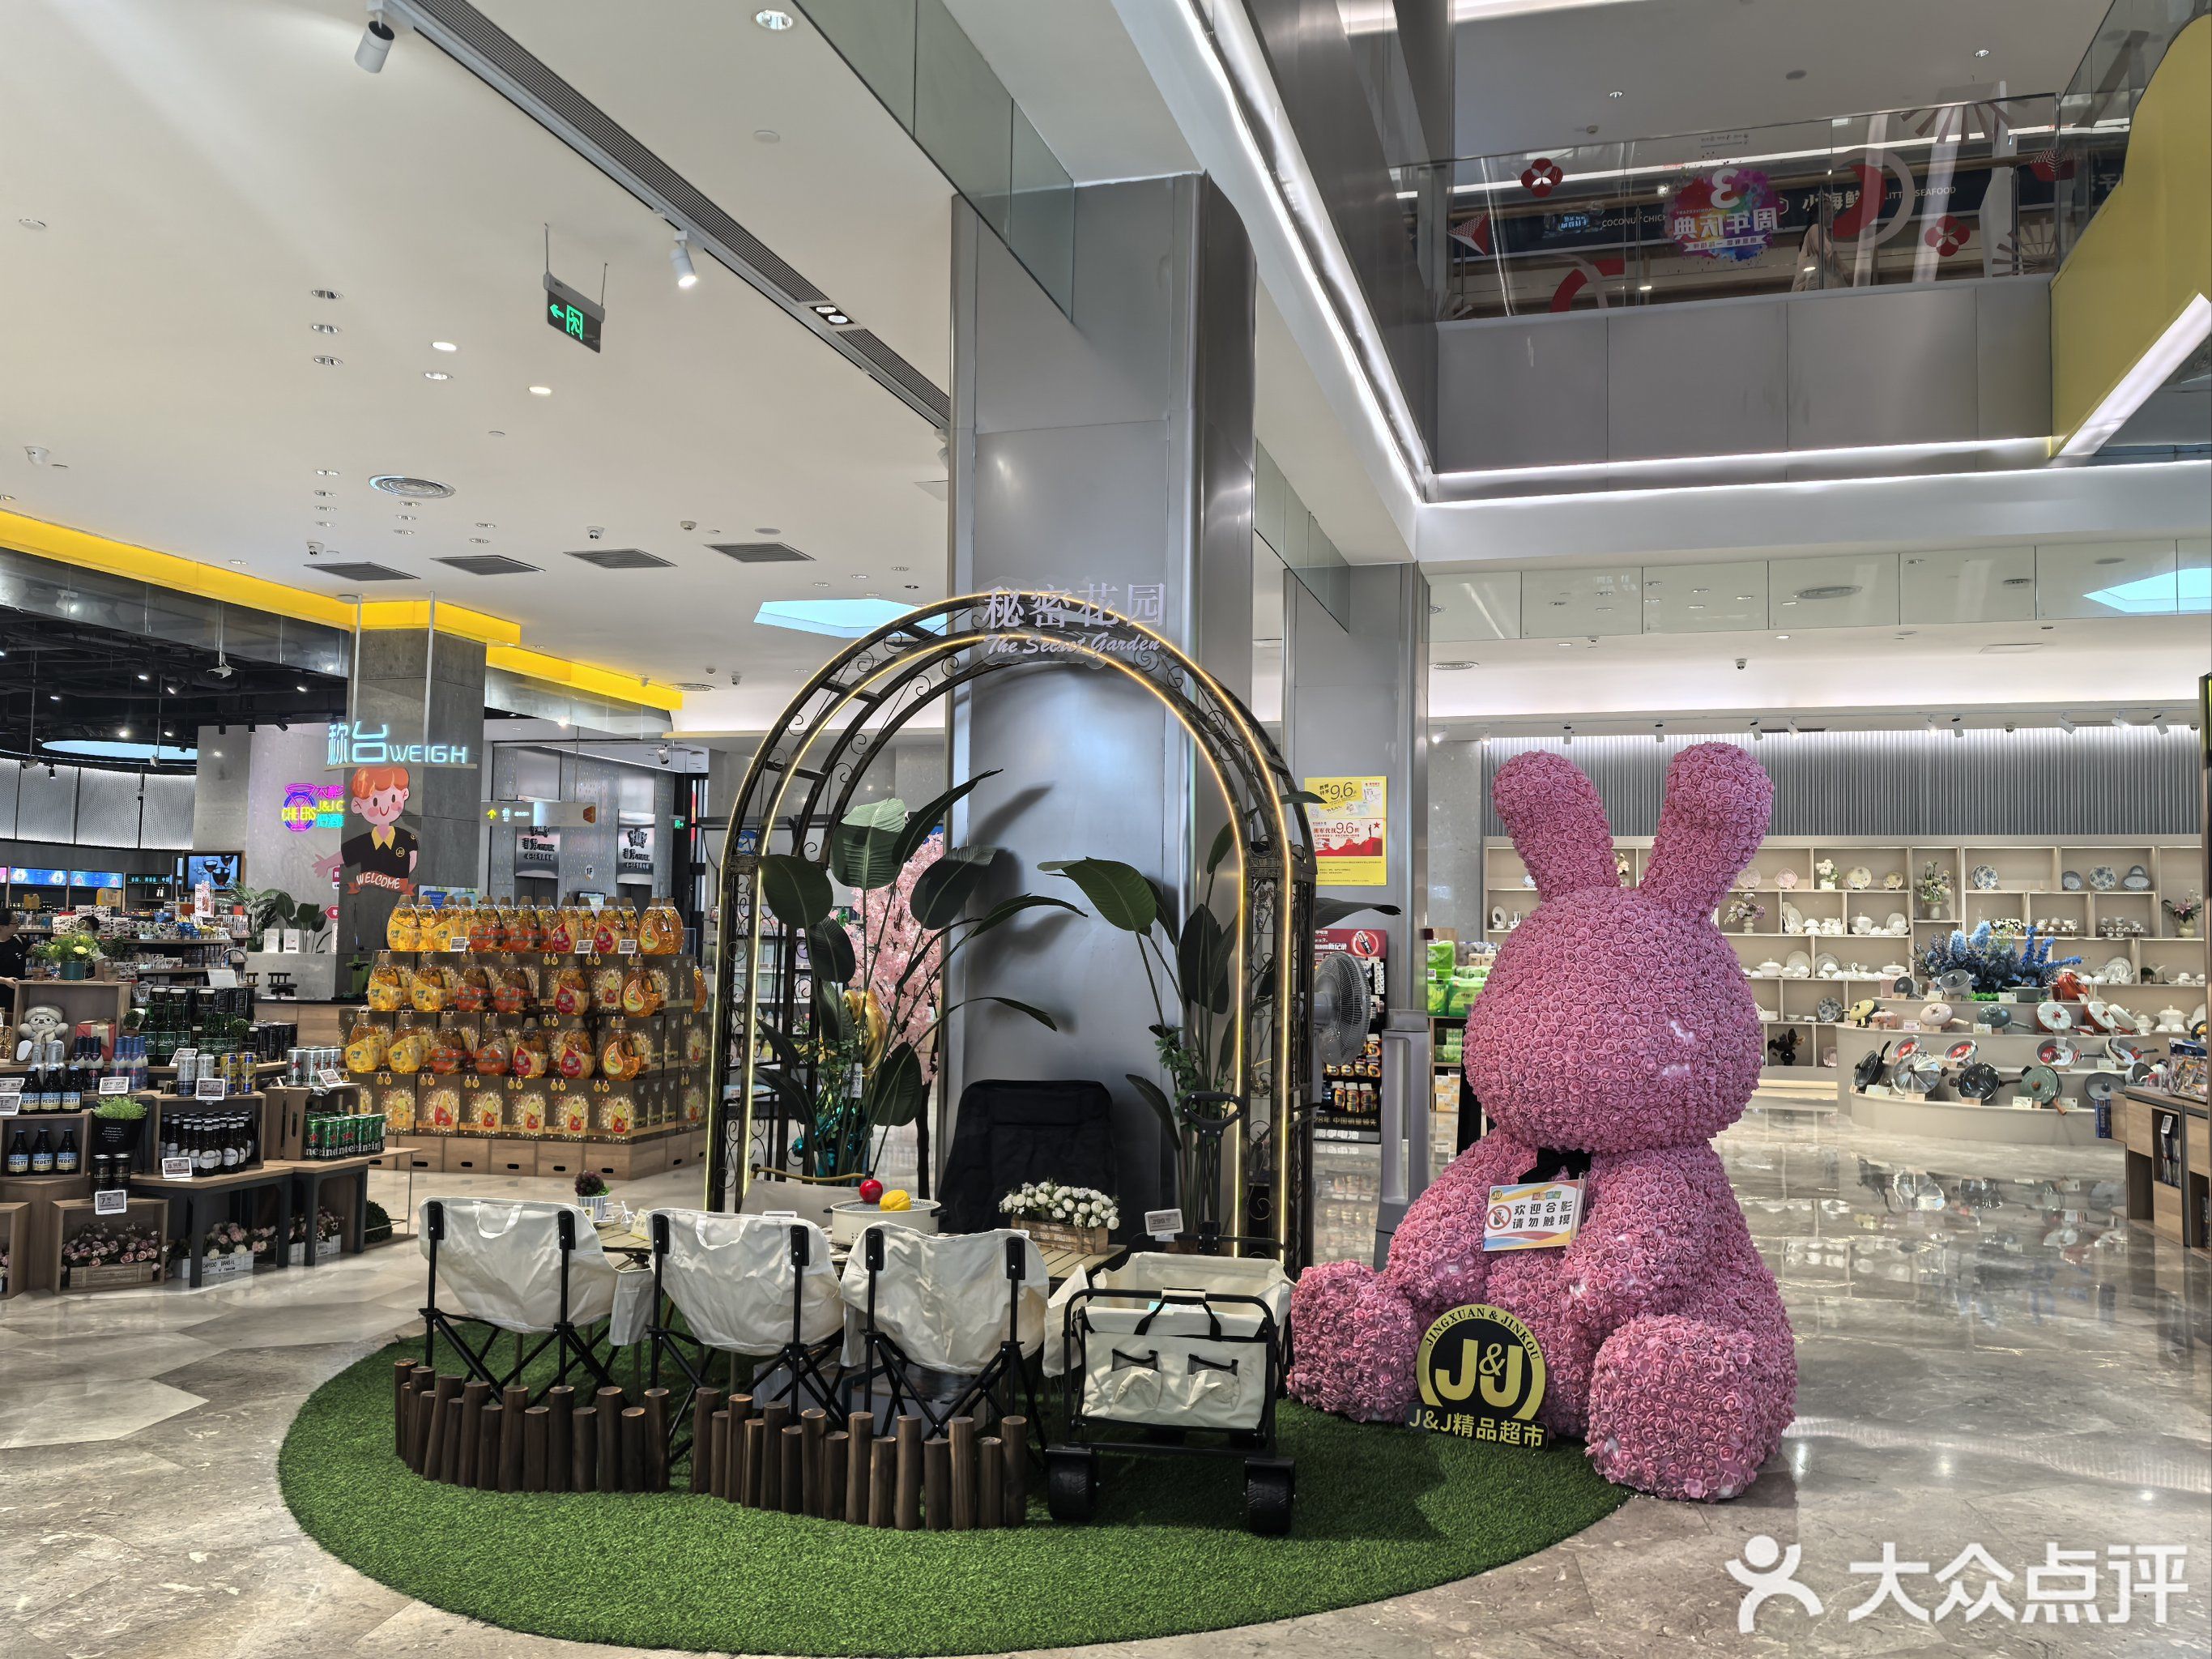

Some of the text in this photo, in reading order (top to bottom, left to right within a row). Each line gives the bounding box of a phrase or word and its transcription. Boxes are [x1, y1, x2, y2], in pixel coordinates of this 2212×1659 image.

[1915, 186, 1956, 197] SEAFOOD
[982, 582, 1165, 629] 秘密花园
[983, 632, 1161, 658] The Secret Garden
[327, 721, 388, 765] 称台
[390, 745, 467, 764] WEIGH
[356, 872, 400, 889] WELCOME
[1512, 1213, 1571, 1229] 请勿触摸
[1514, 1201, 1573, 1215] 欢迎合影
[1425, 1307, 1541, 1360] JINGXUAN & JINKOU
[1434, 1338, 1524, 1408] J&J
[1409, 1408, 1545, 1448] J&J精品超市
